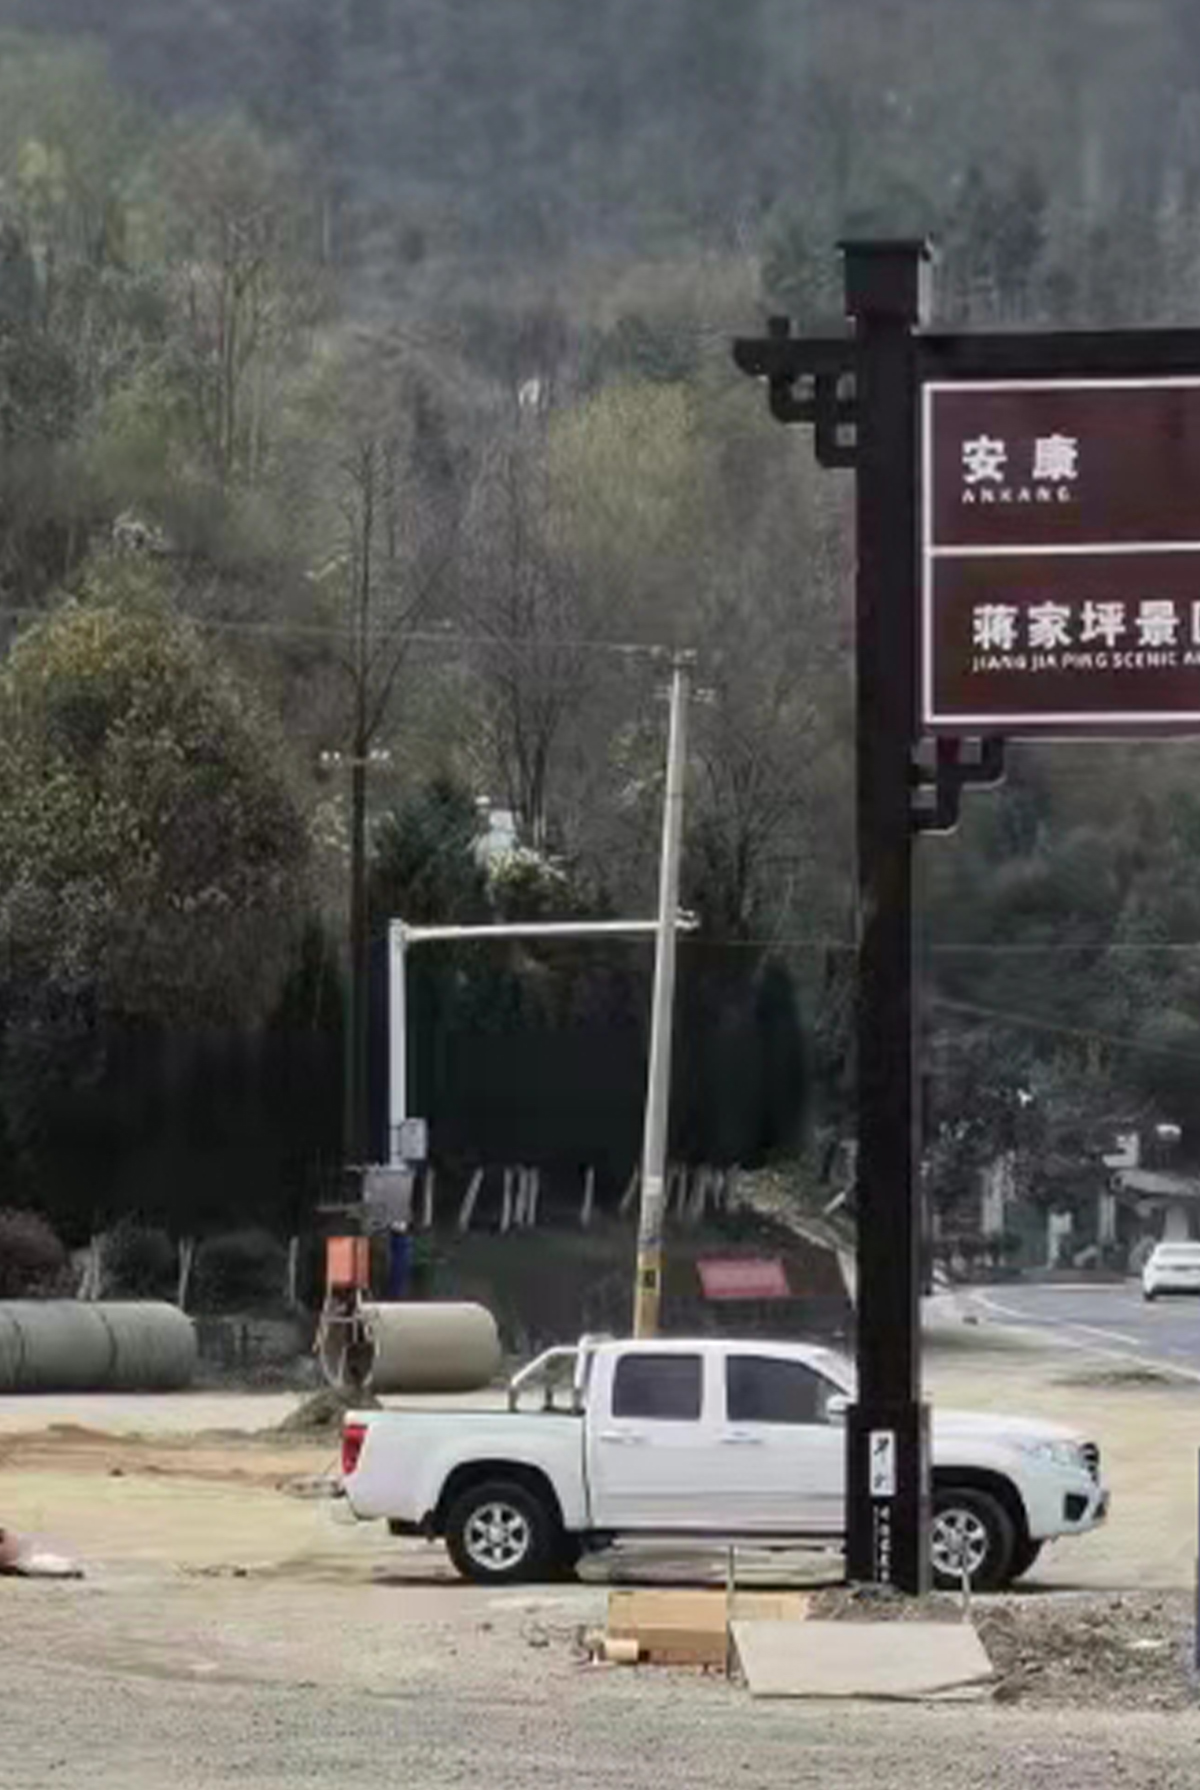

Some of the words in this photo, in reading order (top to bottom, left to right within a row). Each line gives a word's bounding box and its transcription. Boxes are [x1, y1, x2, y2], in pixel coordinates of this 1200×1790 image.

[962, 435, 1078, 482] 安康
[961, 487, 1072, 503] ANKANG
[973, 655, 1027, 672] JIANG
[1031, 653, 1058, 672] JIA
[1061, 652, 1108, 669] PING
[1112, 651, 1177, 669] SCENIC
